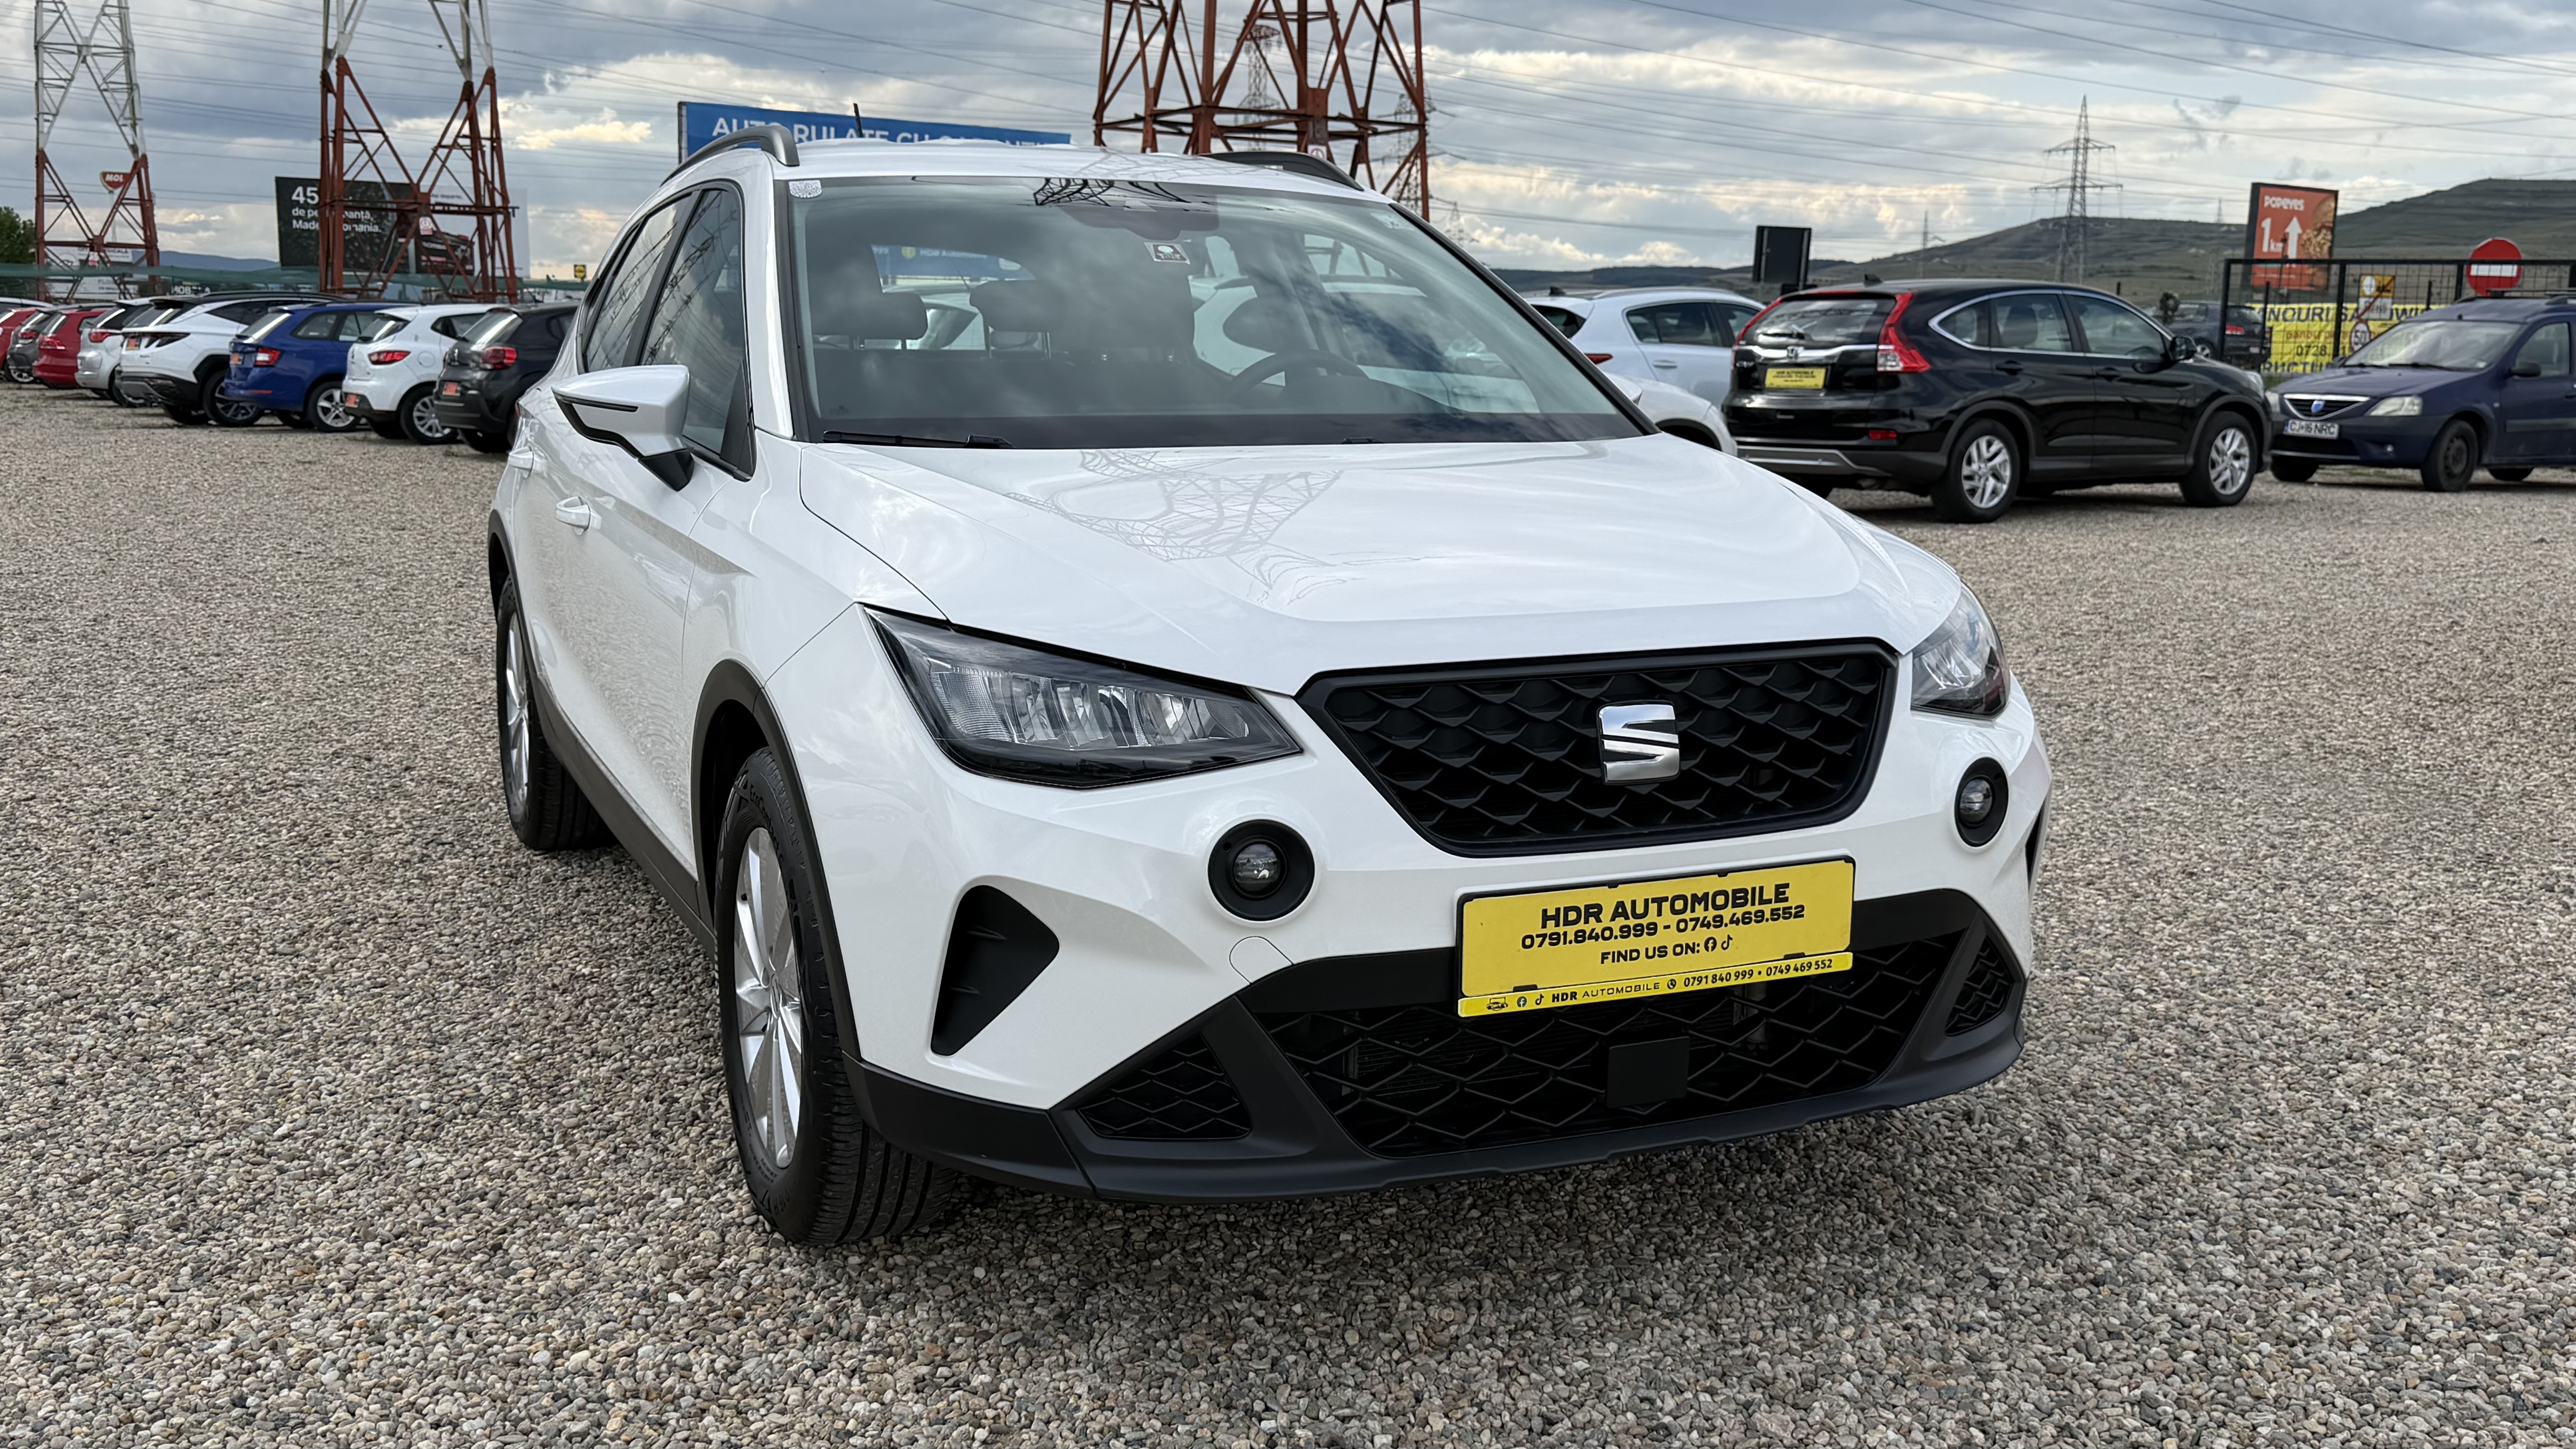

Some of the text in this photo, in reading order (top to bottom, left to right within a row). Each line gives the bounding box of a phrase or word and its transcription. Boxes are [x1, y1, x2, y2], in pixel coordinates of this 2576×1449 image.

[105, 173, 124, 183] MOL
[292, 207, 306, 216] de
[2264, 195, 2305, 211] POPEYES
[2261, 217, 2272, 253] 1
[1541, 883, 1789, 929] HDR AUTOMOBILE
[1521, 921, 1658, 949] 0791.840.999
[1676, 904, 1805, 933] 0749.469.552
[1601, 942, 1700, 964] FIND US ON:
[1552, 958, 1833, 1003] HDR AUTOMOBILE 0791 840 999 0749 469 552
